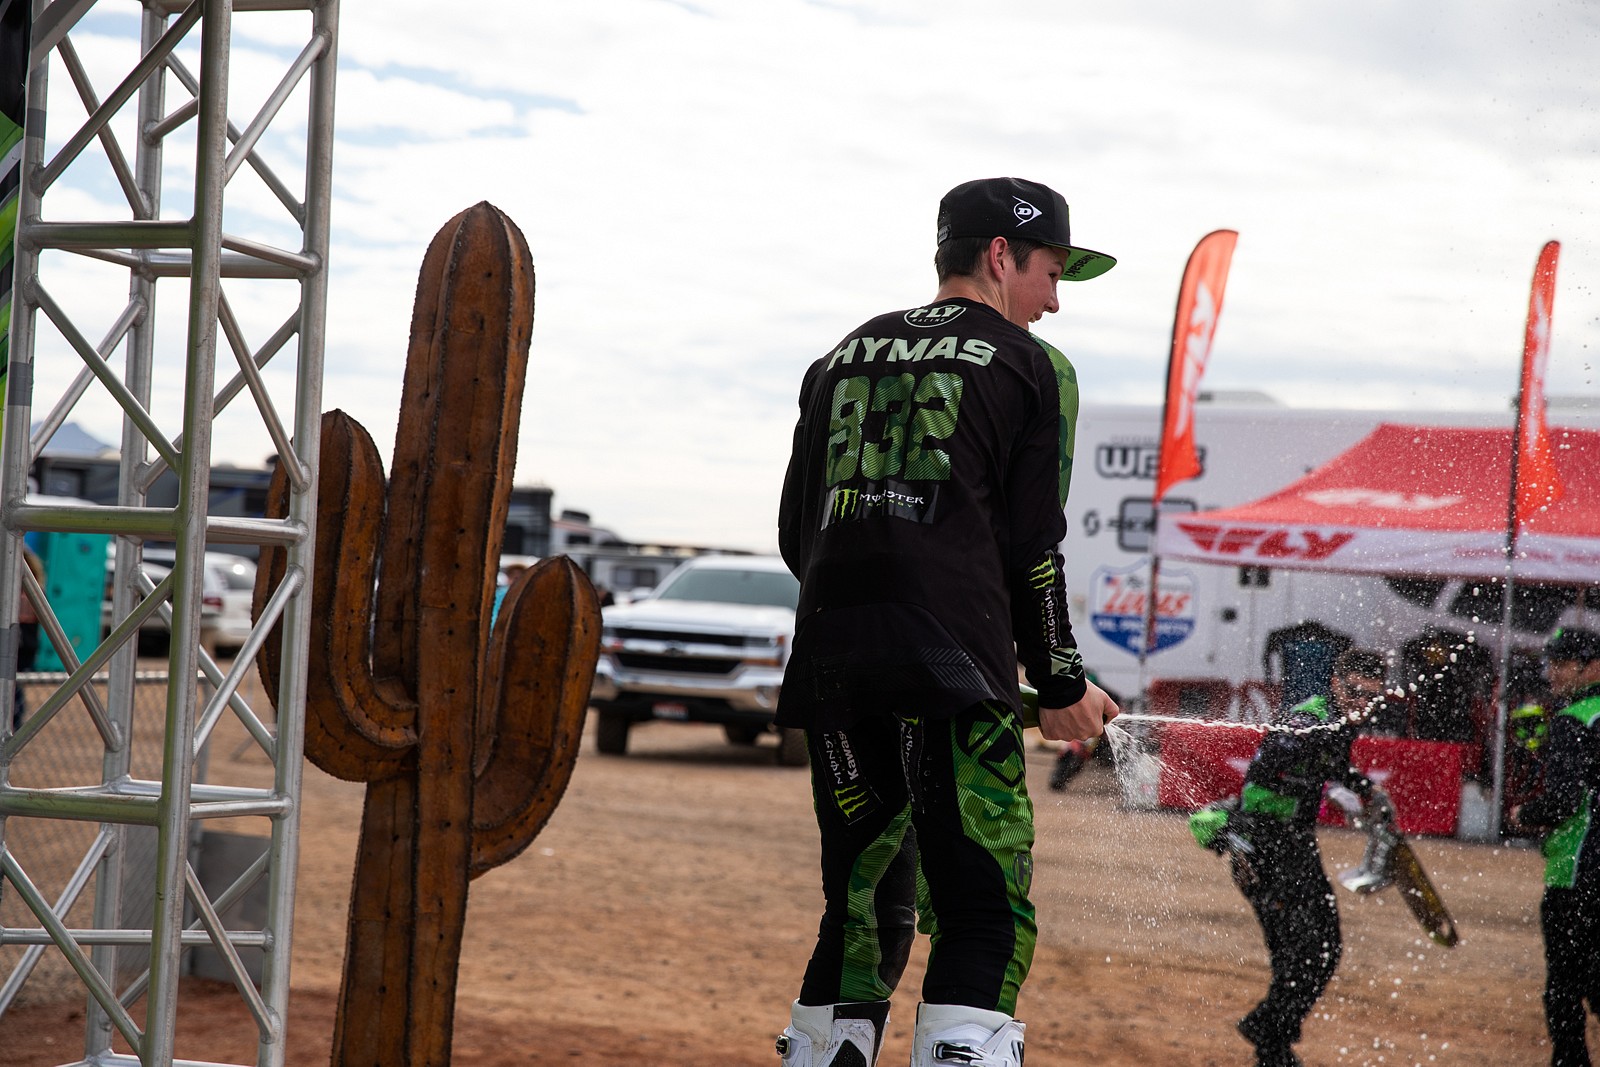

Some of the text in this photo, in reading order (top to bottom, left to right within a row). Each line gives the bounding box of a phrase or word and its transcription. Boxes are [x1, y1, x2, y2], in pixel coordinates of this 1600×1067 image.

[909, 304, 962, 318] FLY
[826, 336, 997, 371] HYMAS
[825, 371, 964, 488] 832
[1214, 528, 1354, 561] FLY
[1044, 588, 1059, 650] MONSTER
[823, 733, 844, 785] MONST
[836, 730, 860, 781] Kawas
